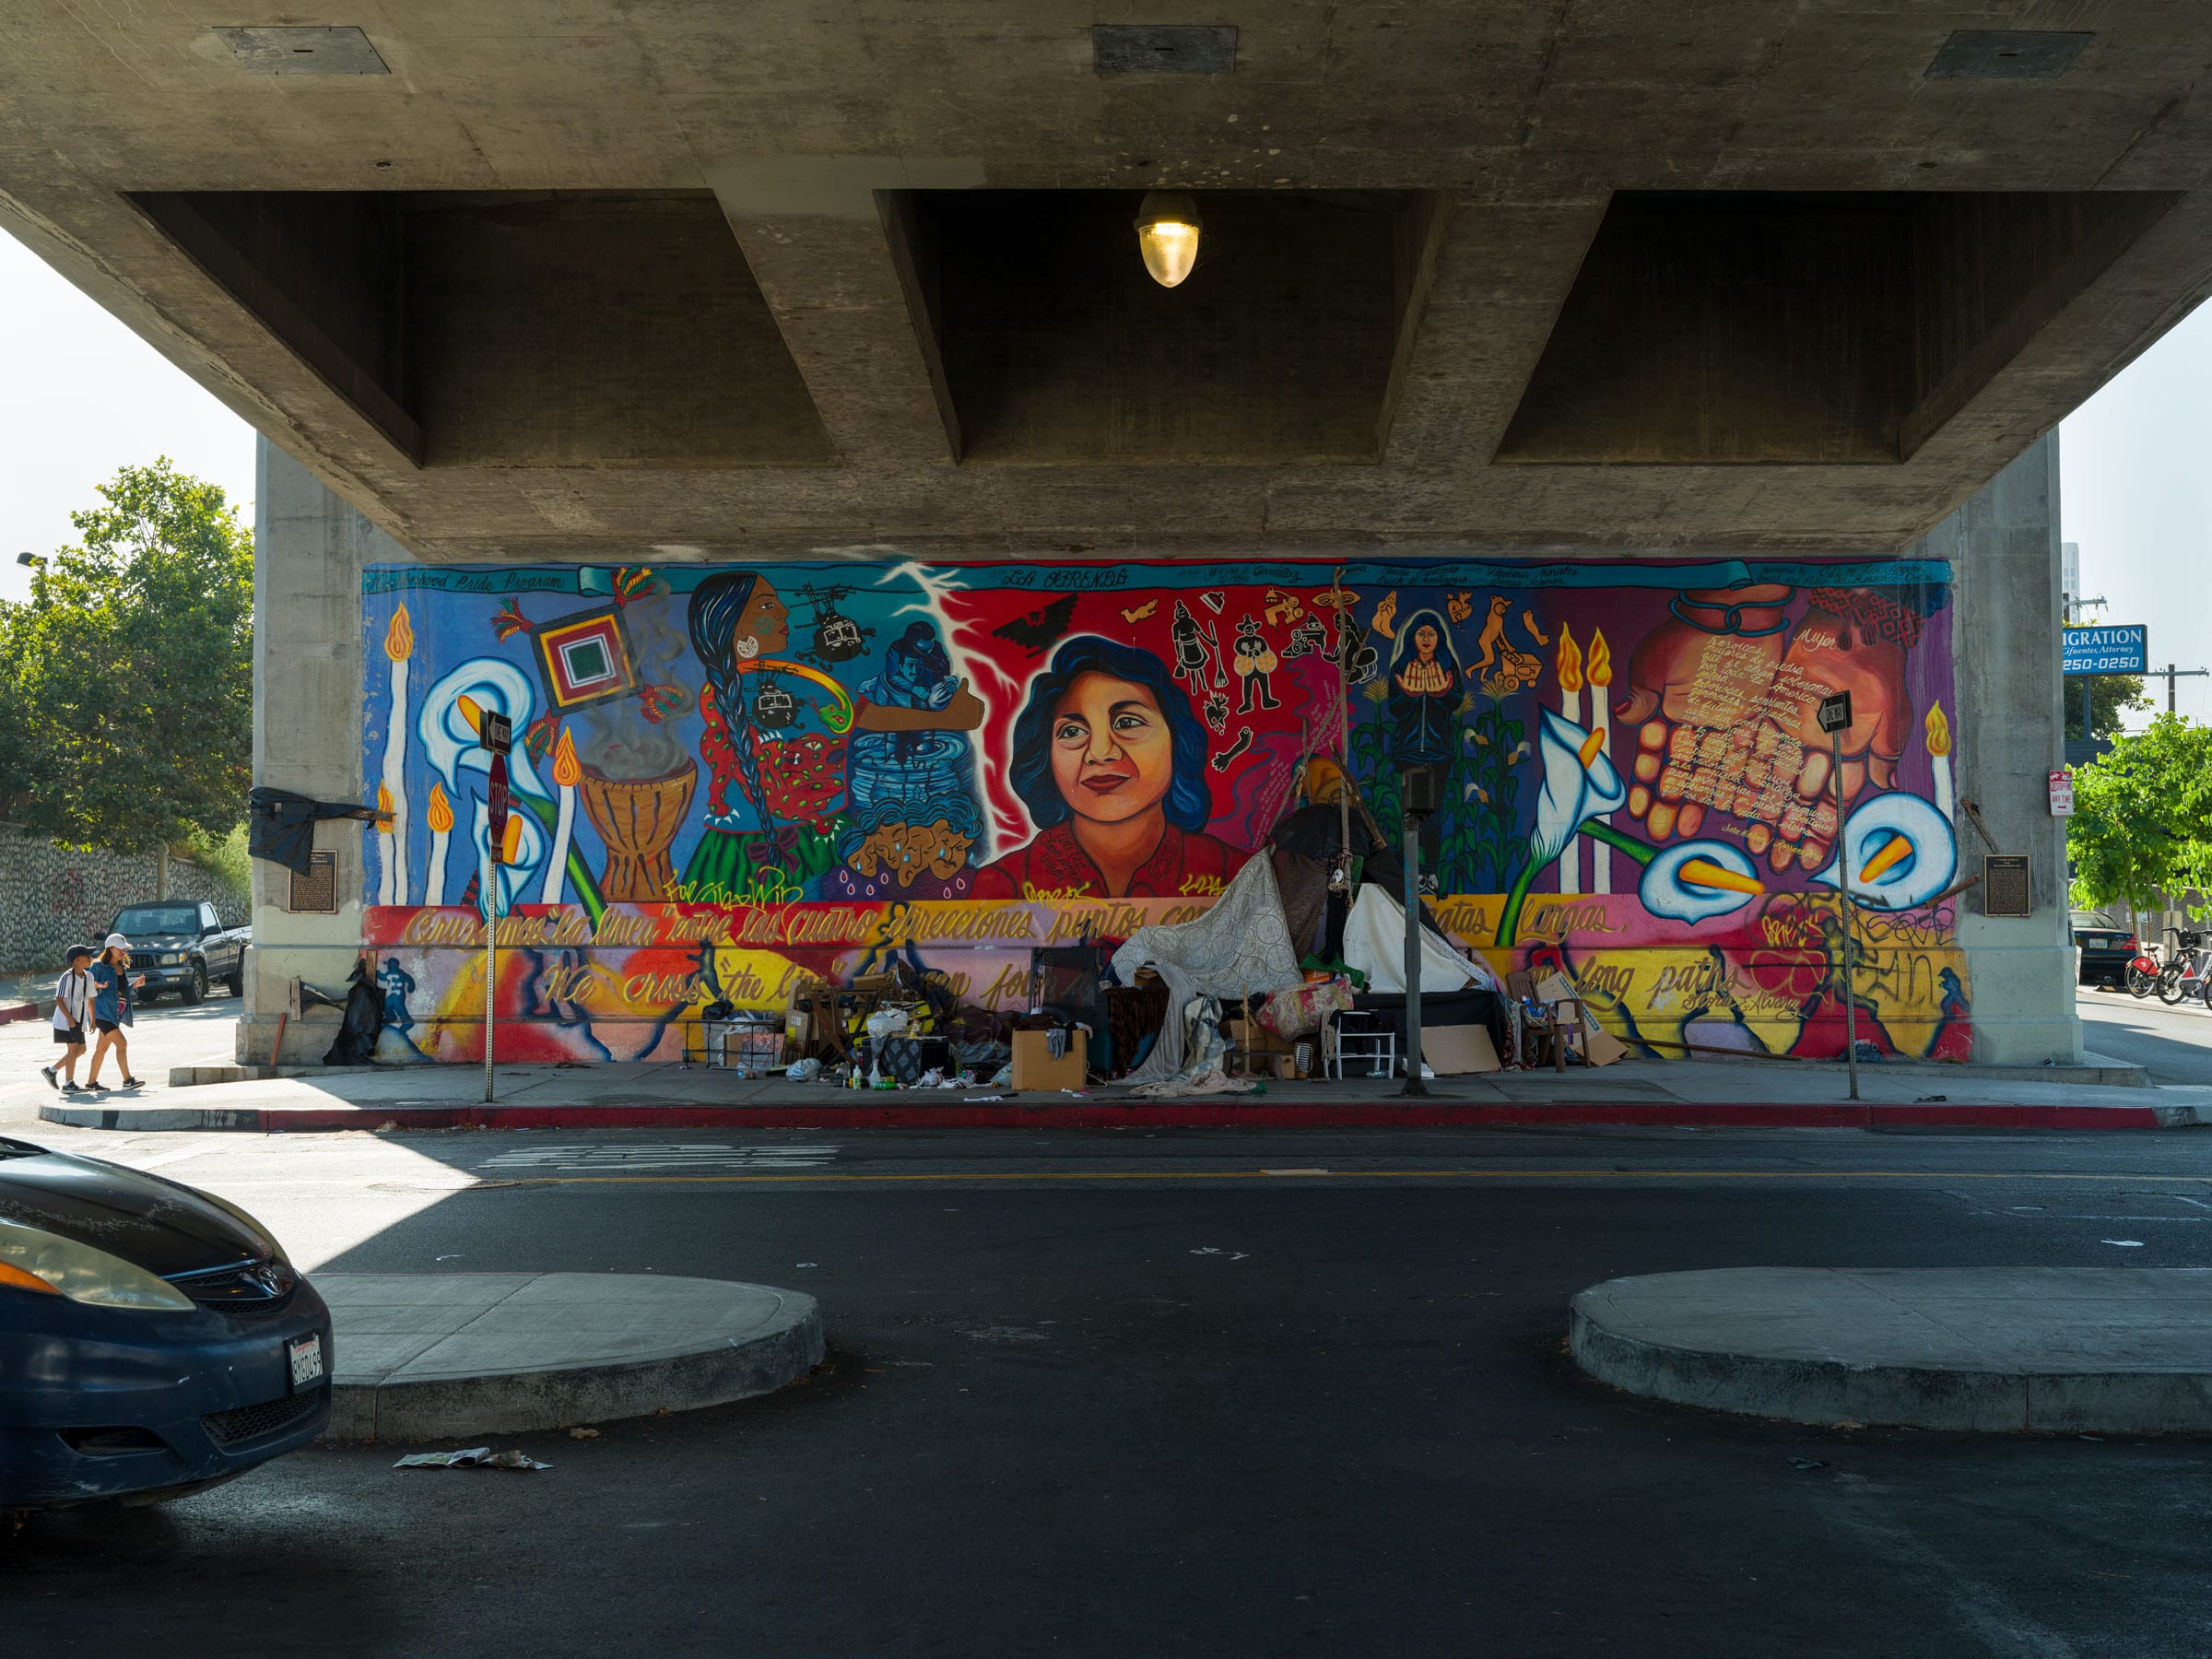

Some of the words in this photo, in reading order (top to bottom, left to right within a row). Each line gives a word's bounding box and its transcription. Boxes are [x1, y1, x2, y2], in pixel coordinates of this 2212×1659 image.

[454, 574, 494, 591] Pride
[504, 572, 564, 591] Program
[1043, 568, 1128, 588] OFRENDA
[1793, 628, 1836, 652] Mujer
[1749, 655, 1764, 665] de
[1719, 666, 1746, 678] toda
[1724, 659, 1740, 668] se
[1778, 675, 1833, 696] soberanas
[1687, 696, 1701, 705] de
[1685, 707, 1710, 718] cada
[1694, 725, 1707, 734] la
[489, 782, 506, 817] STOP
[2052, 795, 2061, 805] ANY
[2061, 795, 2072, 805] TIME
[737, 909, 783, 944] las
[885, 905, 1036, 941] direcciones
[1048, 903, 1149, 946] puntos
[542, 964, 595, 1004] We
[623, 971, 712, 1003] cross
[1573, 956, 1635, 1011] long
[1644, 958, 1751, 1009] paths
